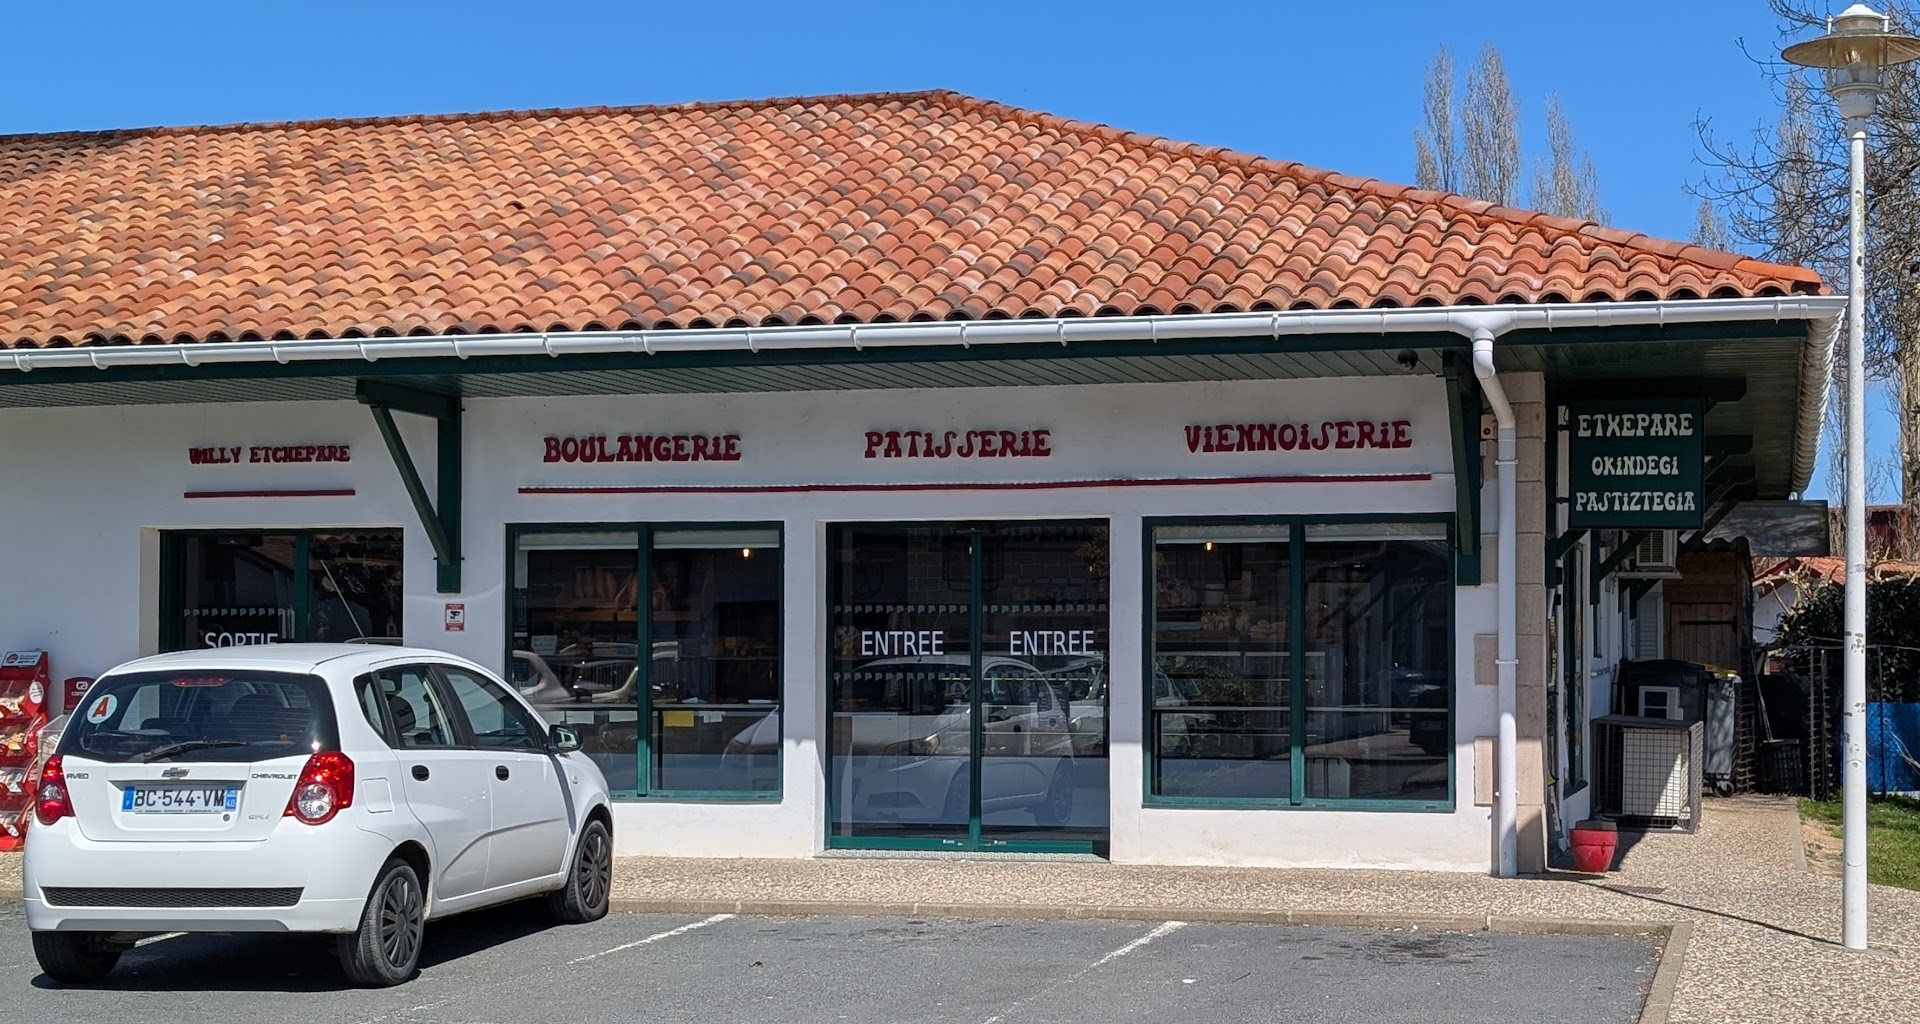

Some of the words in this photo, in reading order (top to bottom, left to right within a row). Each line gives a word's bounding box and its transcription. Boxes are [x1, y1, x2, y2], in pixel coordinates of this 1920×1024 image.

[1577, 413, 1694, 437] ETXEPARE
[249, 446, 351, 463] ETCHEPARE
[861, 631, 944, 656] ENTREE
[1009, 630, 1094, 656] ENTREE
[92, 697, 110, 718] A
[135, 789, 225, 807] BC-544-VM
